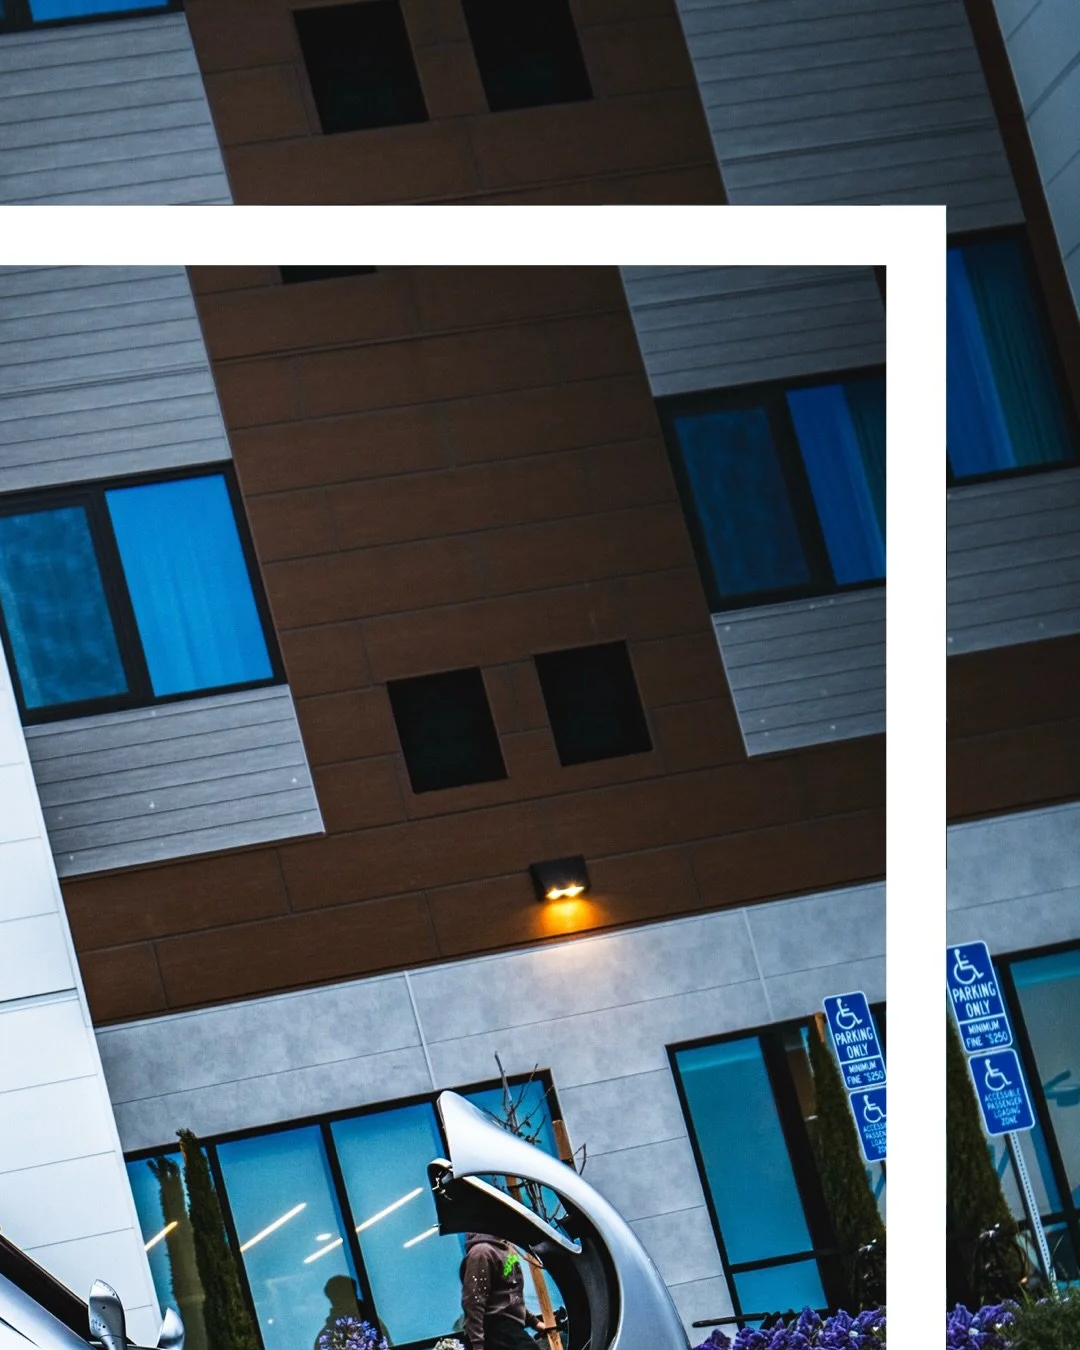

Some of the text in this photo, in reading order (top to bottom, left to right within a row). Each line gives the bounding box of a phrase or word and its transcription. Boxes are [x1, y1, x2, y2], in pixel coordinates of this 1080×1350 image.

[952, 981, 996, 1003] PARKING
[965, 999, 990, 1018] ONLY
[968, 1019, 1000, 1035] MINIMUM
[835, 1027, 873, 1046] PARKING
[966, 1030, 1008, 1048] FINE $250
[847, 1043, 868, 1059] ONLY
[849, 1061, 876, 1073] MINIMUM
[847, 1070, 884, 1085] FINE $250
[985, 1087, 1021, 1102] ACCESSIBLE
[987, 1096, 1022, 1110] PASSENGER
[993, 1104, 1020, 1118] LOADING
[1001, 1114, 1018, 1126] ZONE
[871, 1138, 886, 1147] LOAD
